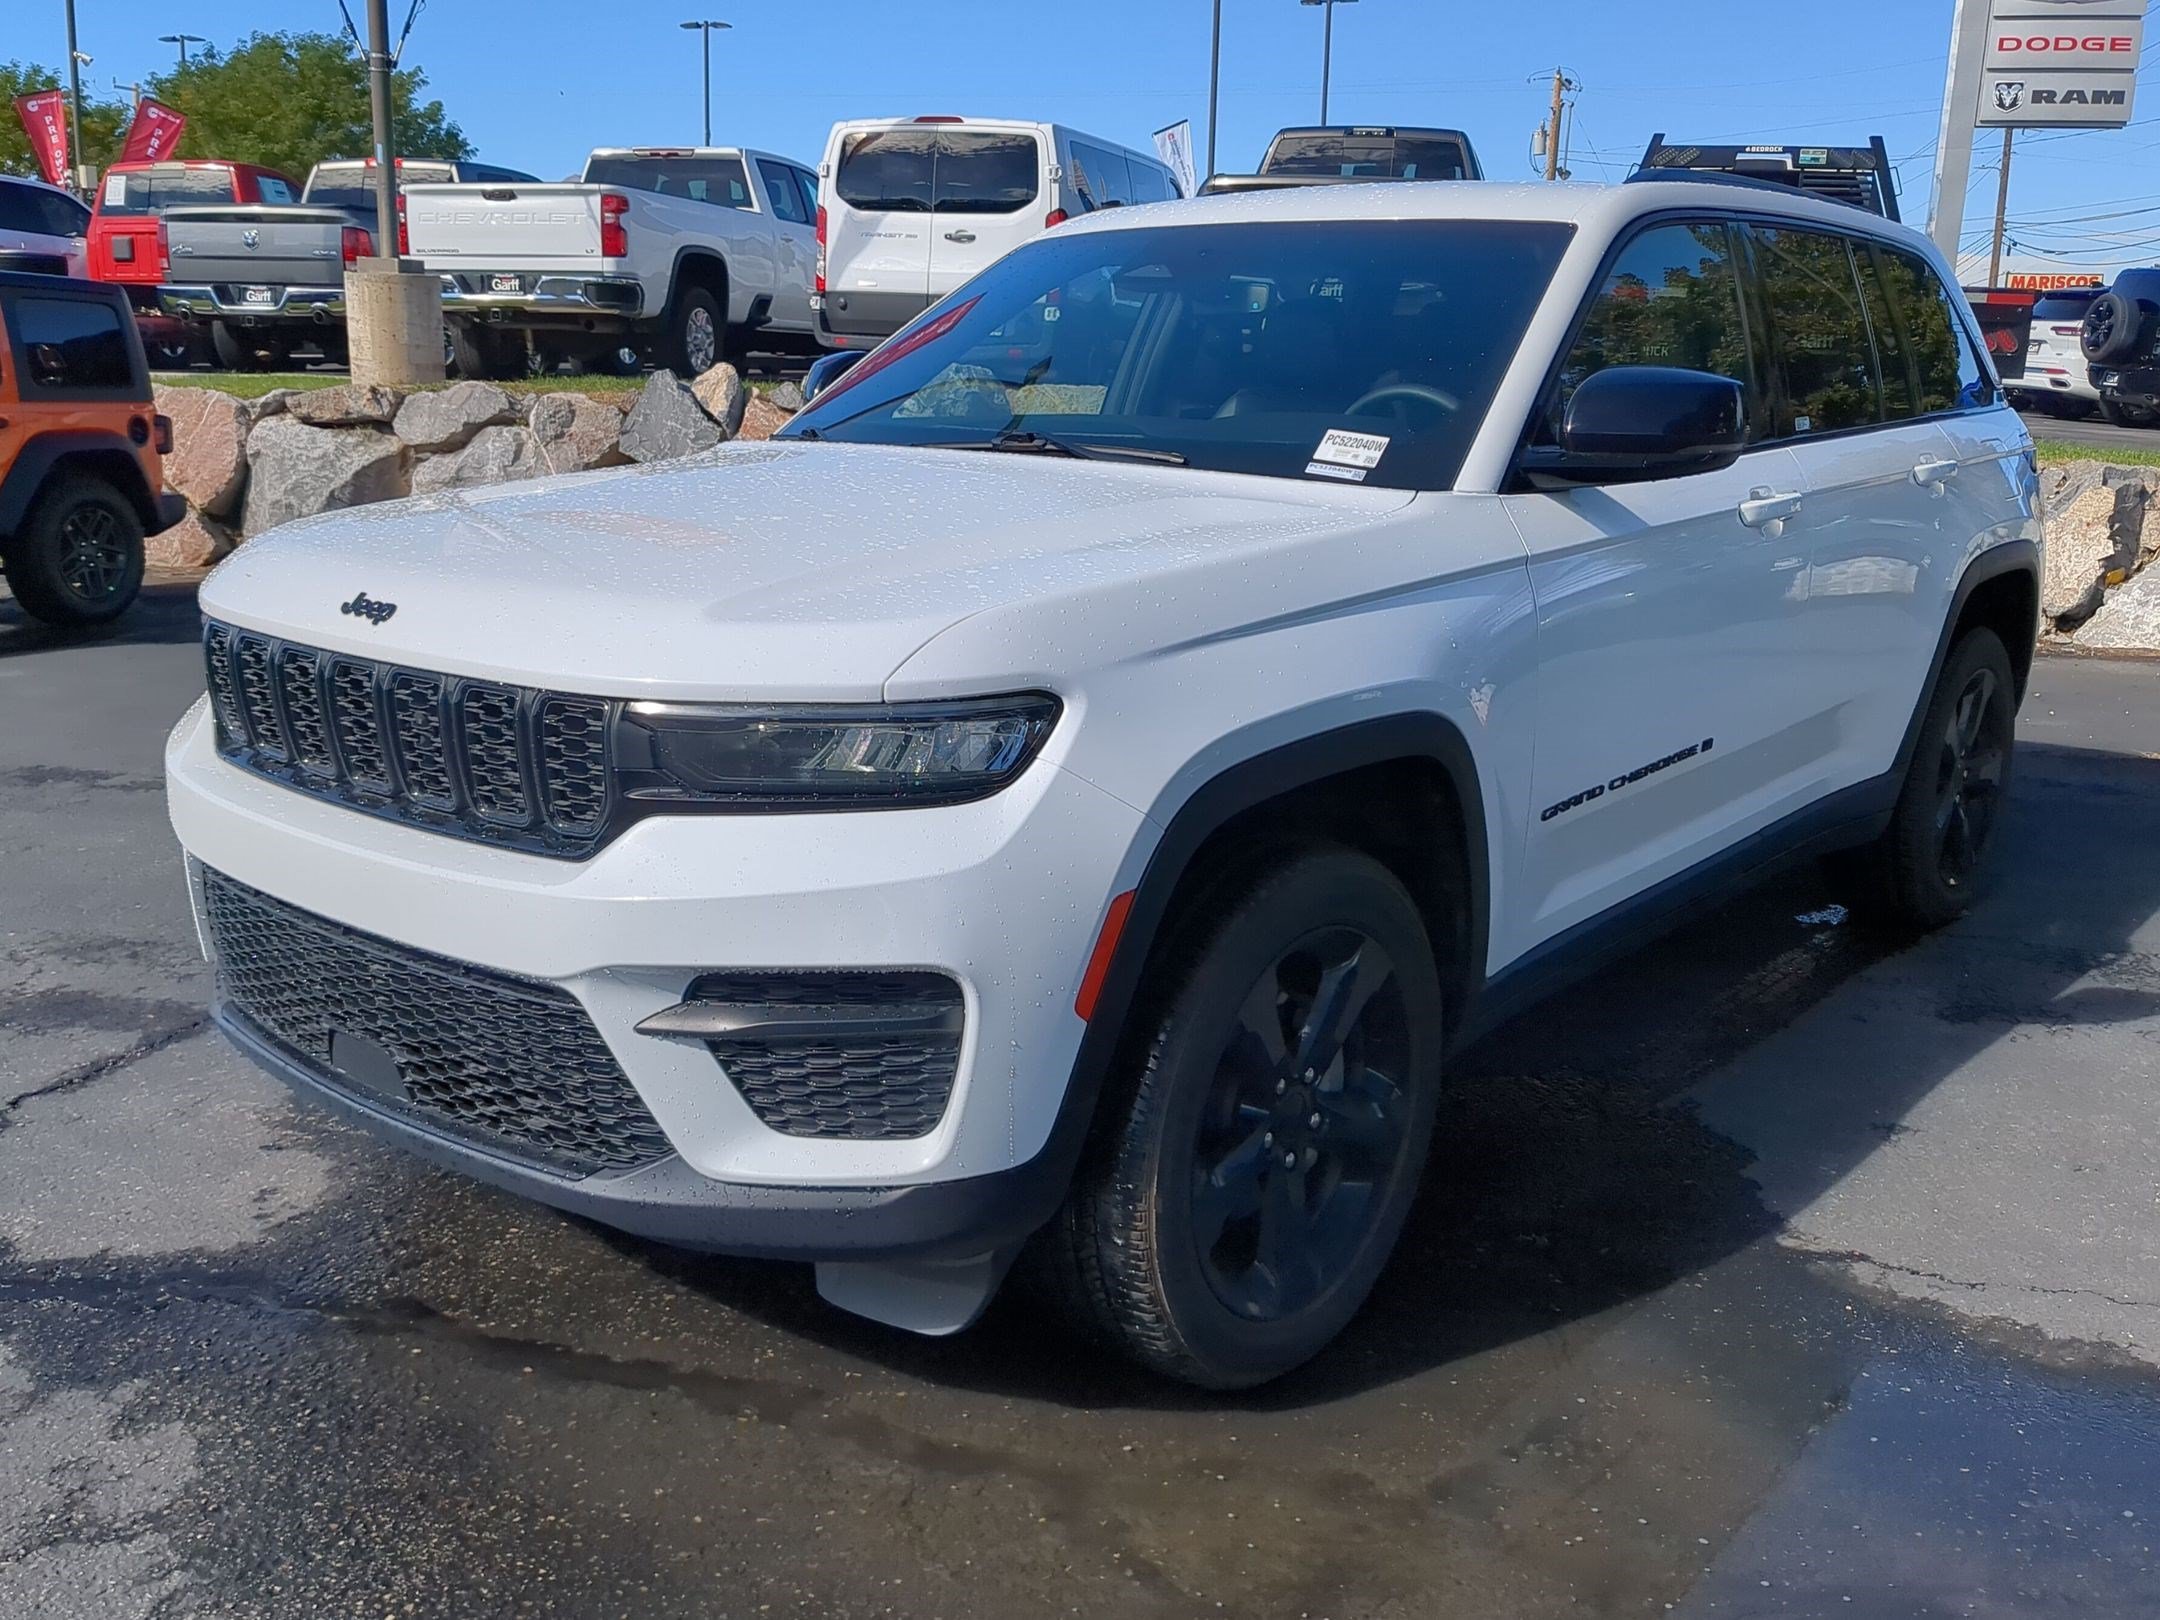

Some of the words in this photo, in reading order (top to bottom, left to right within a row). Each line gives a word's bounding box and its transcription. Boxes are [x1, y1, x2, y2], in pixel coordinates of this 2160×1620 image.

[1998, 36, 2133, 52] DODGE
[2030, 89, 2126, 105] RAM
[44, 115, 59, 144] PRE
[146, 128, 163, 157] PRE
[418, 212, 588, 225] CHEVROLET
[492, 278, 520, 291] Garff
[246, 290, 271, 302] Garff
[1325, 433, 1387, 452] PC522040W
[341, 591, 398, 626] Jeep
[1540, 784, 1605, 822] GRAND
[1607, 743, 1700, 791] CHEROKEE
